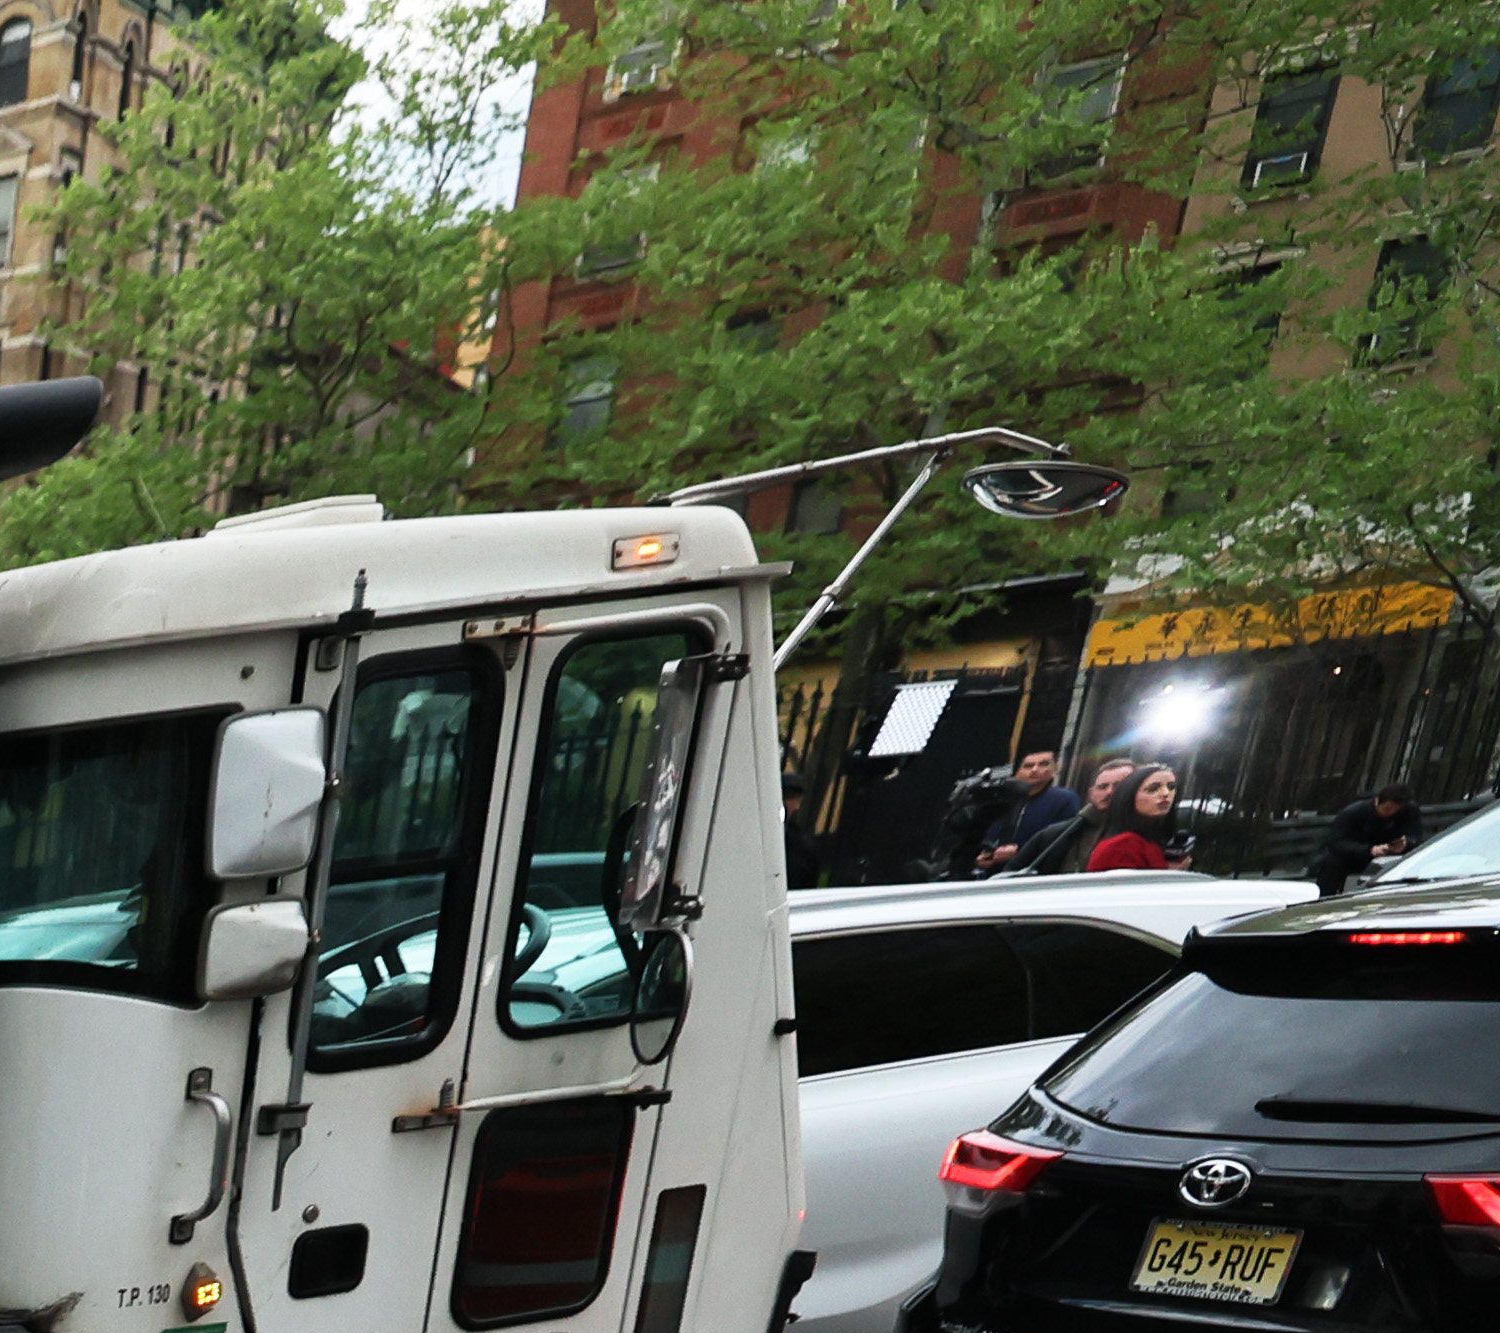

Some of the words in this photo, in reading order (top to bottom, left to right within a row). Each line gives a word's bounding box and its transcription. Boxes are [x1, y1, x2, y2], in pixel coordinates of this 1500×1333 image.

[1147, 1238, 1207, 1275] G45
[1218, 1244, 1285, 1283] RUF
[117, 1287, 143, 1308] T.P.
[147, 1283, 171, 1306] 130
[1167, 1277, 1207, 1290] Garden
[1212, 1281, 1242, 1293] State
